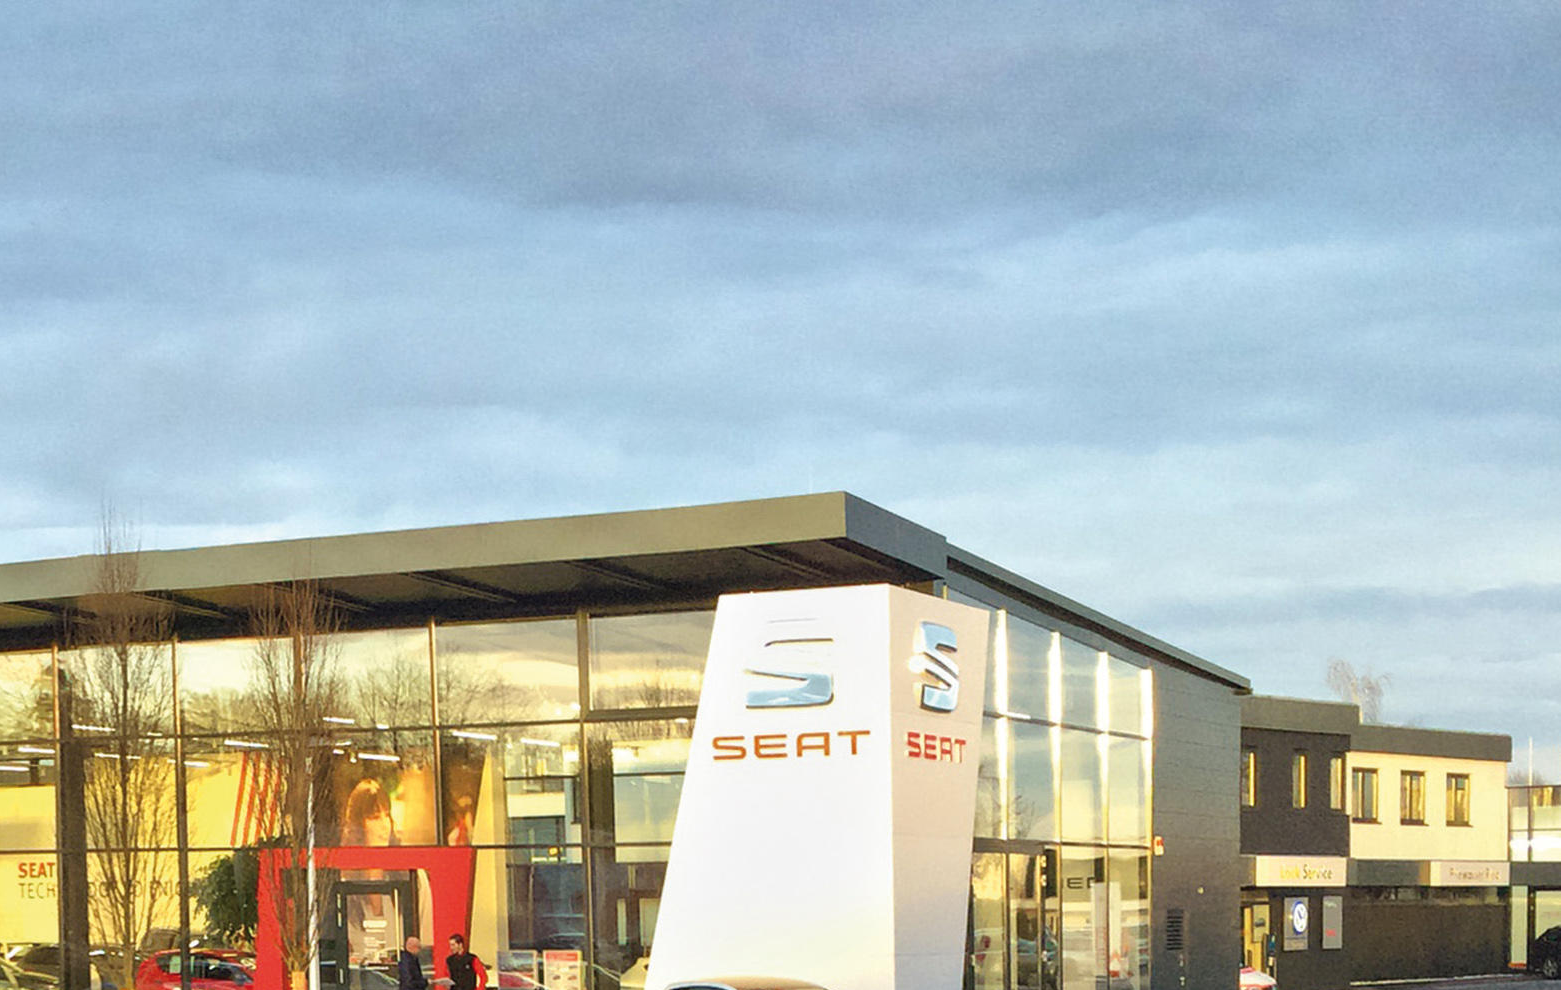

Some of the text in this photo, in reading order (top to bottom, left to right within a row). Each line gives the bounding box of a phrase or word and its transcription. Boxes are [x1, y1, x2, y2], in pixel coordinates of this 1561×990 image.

[712, 730, 871, 760] SEAT
[904, 731, 967, 763] SEAT
[18, 862, 56, 878] SEAT
